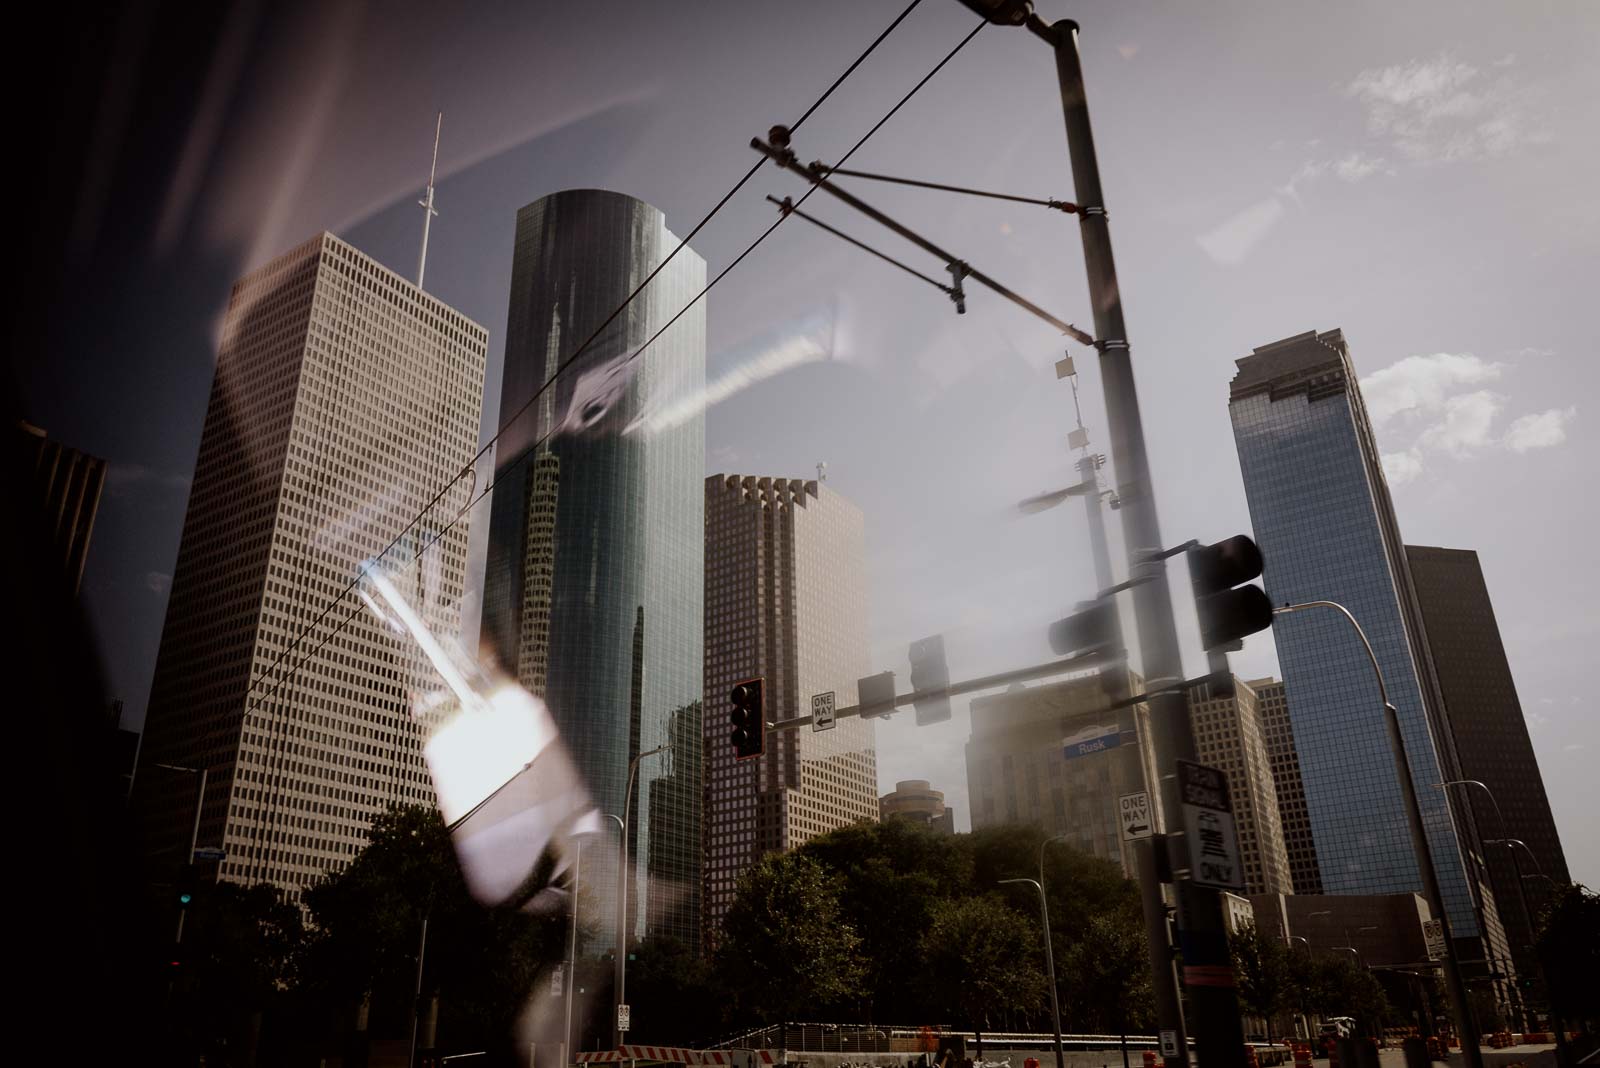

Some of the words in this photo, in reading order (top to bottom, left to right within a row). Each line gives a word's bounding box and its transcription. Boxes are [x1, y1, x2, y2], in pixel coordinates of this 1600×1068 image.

[814, 695, 832, 707] ONE
[814, 705, 832, 718] WAY
[1078, 739, 1106, 755] Rusk
[1121, 795, 1146, 810] ONE
[1122, 808, 1147, 823] WAY
